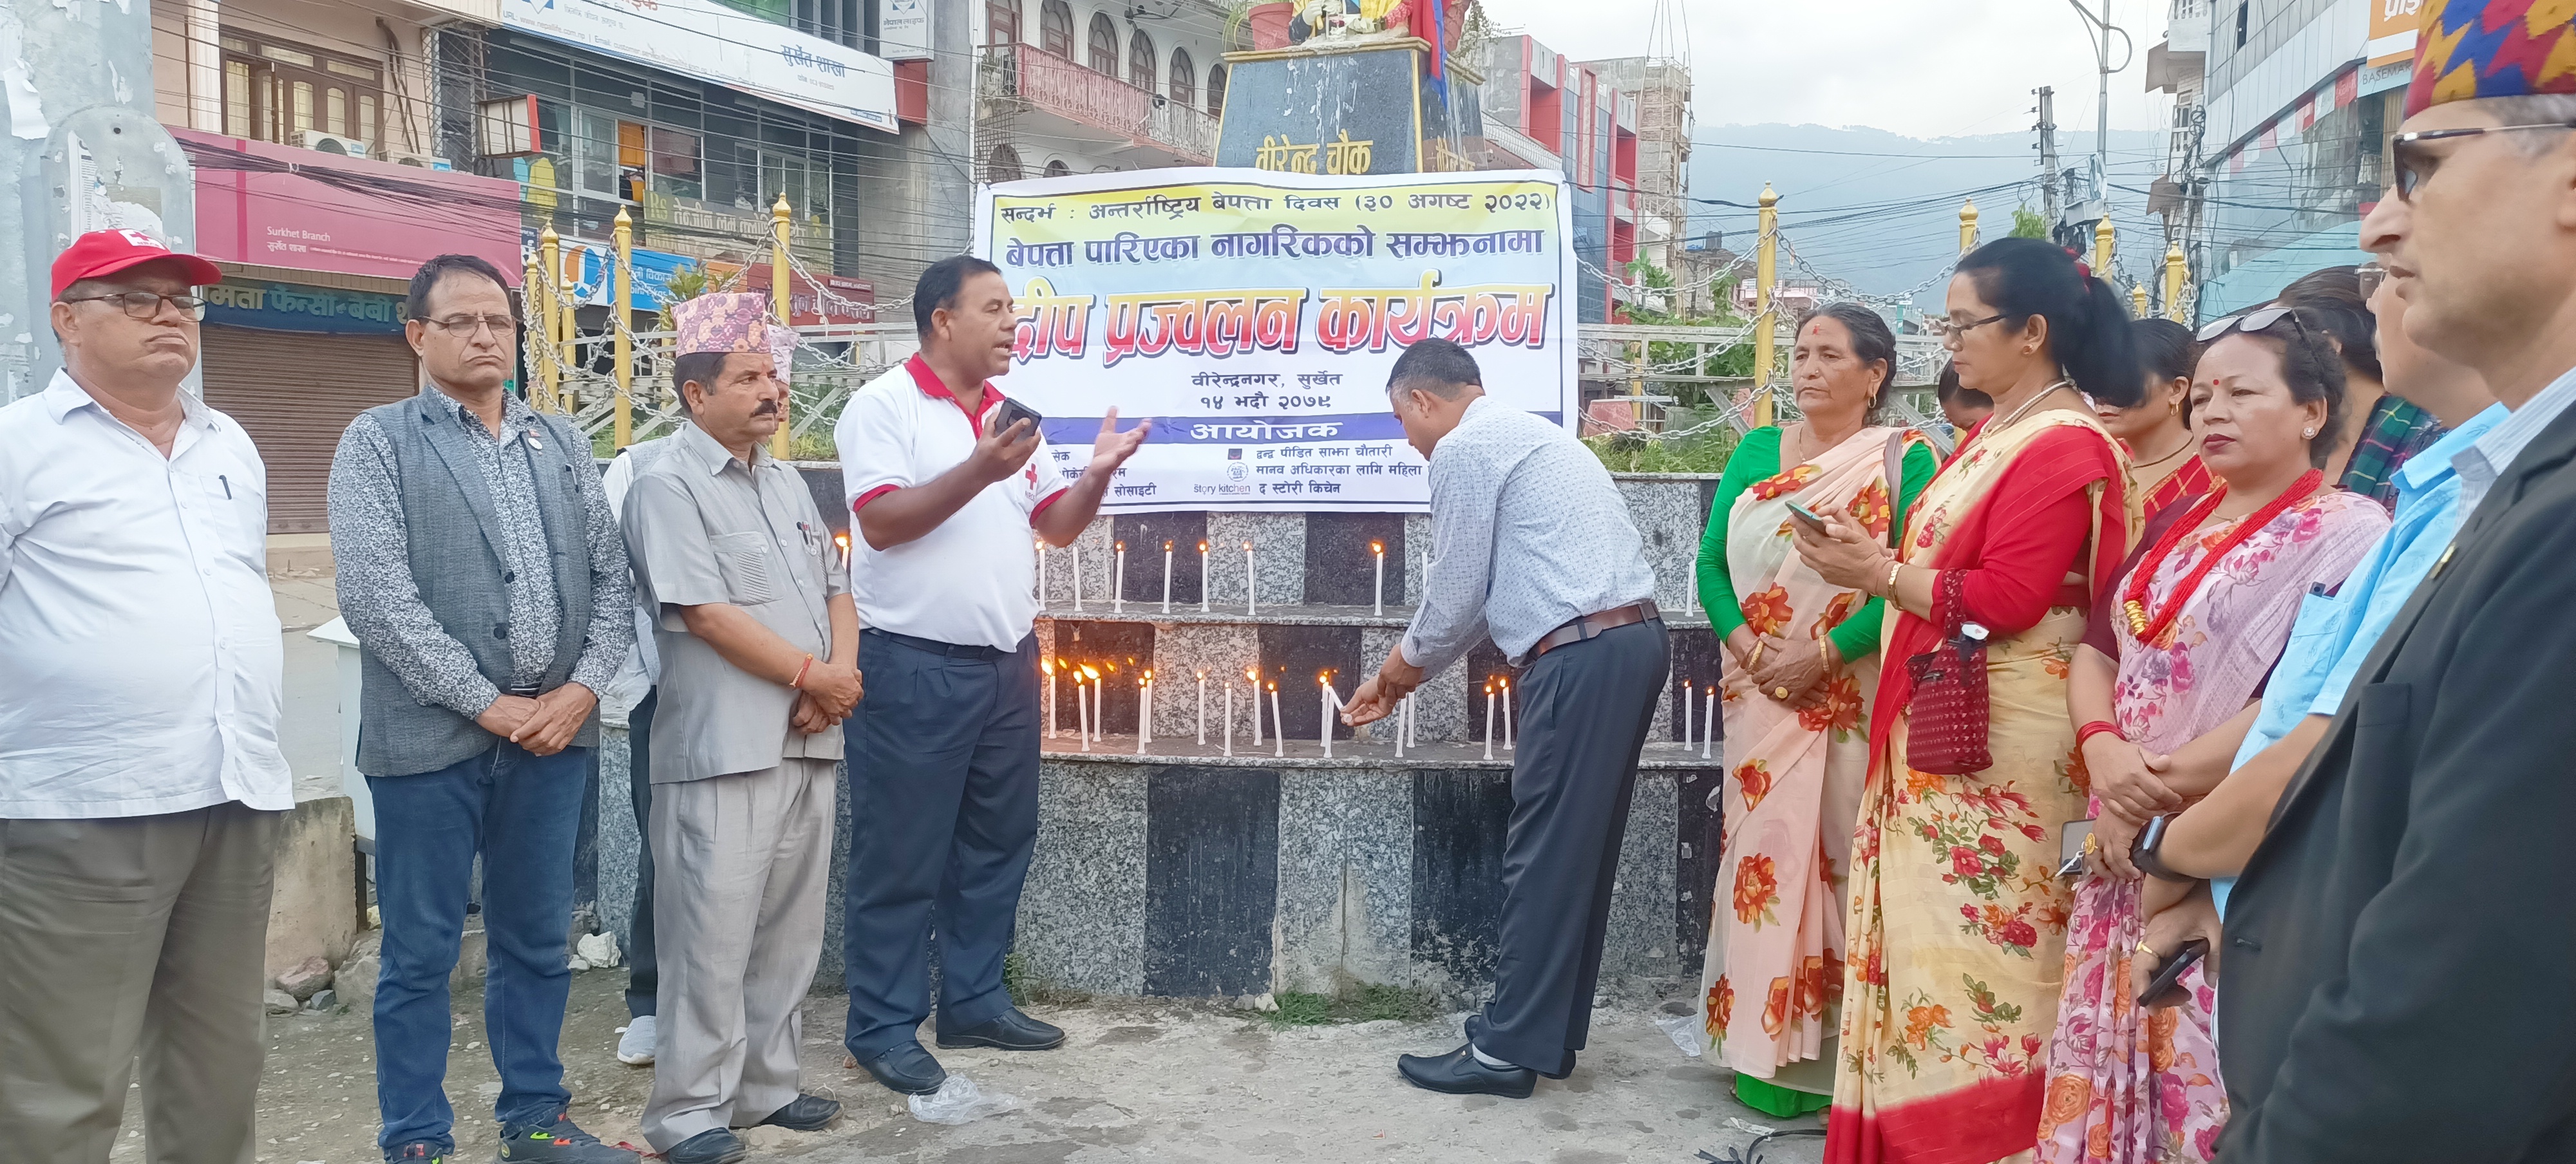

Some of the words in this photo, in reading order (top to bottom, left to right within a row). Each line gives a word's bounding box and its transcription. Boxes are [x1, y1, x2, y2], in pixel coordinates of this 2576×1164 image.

[781, 44, 813, 67] सुर्खेत
[816, 55, 845, 78] शाखा
[2362, 63, 2411, 85] BASEMAR
[1001, 203, 1056, 223] सन्दर्भ
[1212, 192, 1273, 211] बेपत्ता
[1283, 194, 1341, 211] दिवस
[1355, 194, 1393, 212] (३०
[1408, 194, 1473, 209] अगष्ट
[1485, 192, 1549, 213] २०२२)
[267, 226, 299, 239] Surkhet
[302, 230, 330, 242] Branch
[1006, 238, 1075, 267] बेपत्ता
[1084, 232, 1201, 264] पारिएका
[1211, 224, 1375, 259] नागरिकको
[1103, 287, 1309, 368] प्रज्वलन
[1315, 268, 1555, 355] कार्यक्रम
[1191, 371, 1285, 388] वीरेन्द्रनगर,
[1296, 370, 1343, 390] सुर्खेत
[1200, 395, 1224, 409] १४
[1234, 391, 1269, 409] भदौ
[1278, 395, 1331, 409] २०७९
[1190, 420, 1343, 440] आयोजक
[1052, 449, 1070, 462] सेक
[1280, 446, 1313, 458] पीडित
[1355, 444, 1393, 458] चौतारी
[1256, 465, 1285, 476] मानव
[1290, 462, 1350, 476] अधिकारका
[1356, 462, 1383, 476] लागि
[1388, 462, 1423, 478] महिला
[1114, 482, 1157, 497] सोसाइटी
[1218, 484, 1250, 493] kitchen
[1259, 483, 1267, 495] द
[1273, 480, 1303, 495] स्टोरी
[1309, 480, 1341, 494] किचेन
